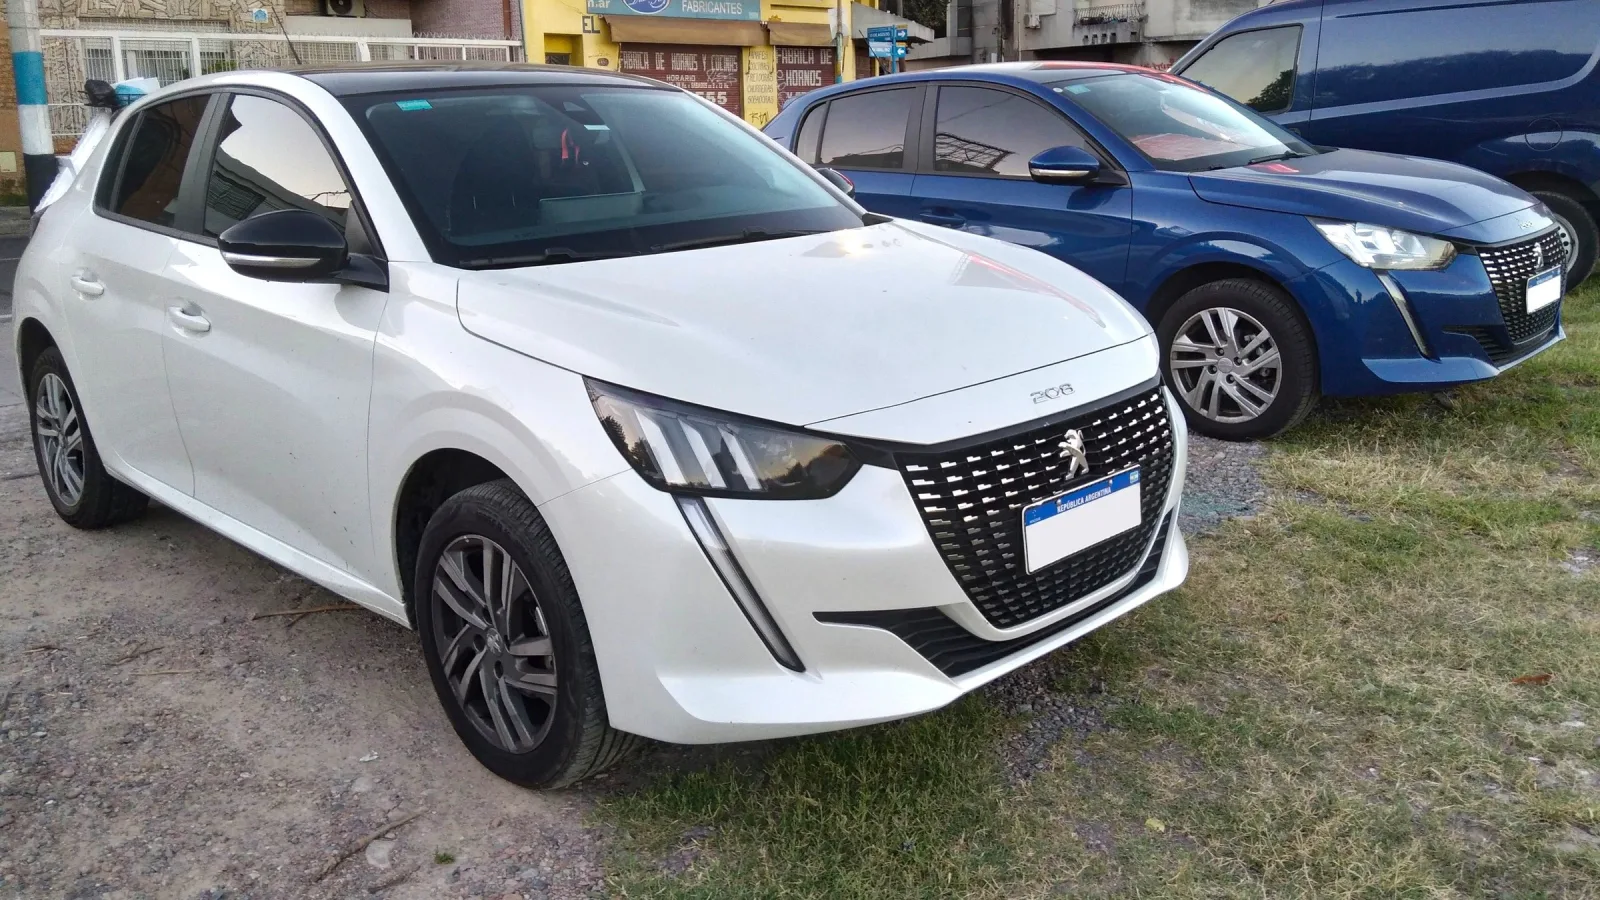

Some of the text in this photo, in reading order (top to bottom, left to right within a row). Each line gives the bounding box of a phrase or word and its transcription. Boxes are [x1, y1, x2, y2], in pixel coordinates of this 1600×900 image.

[681, 0, 743, 15] FABRICANTES
[582, 15, 600, 33] EL
[620, 51, 649, 70] FABRICA
[655, 52, 665, 70] DE
[671, 53, 698, 71] HORNOS
[702, 54, 707, 72] Y
[710, 54, 738, 72] COCINAS
[776, 48, 832, 65] FABRICA DE
[666, 74, 696, 82] HORARIO
[785, 69, 822, 86] HORNOS
[1056, 486, 1112, 513] REPÚBLICA ARGENTINA
